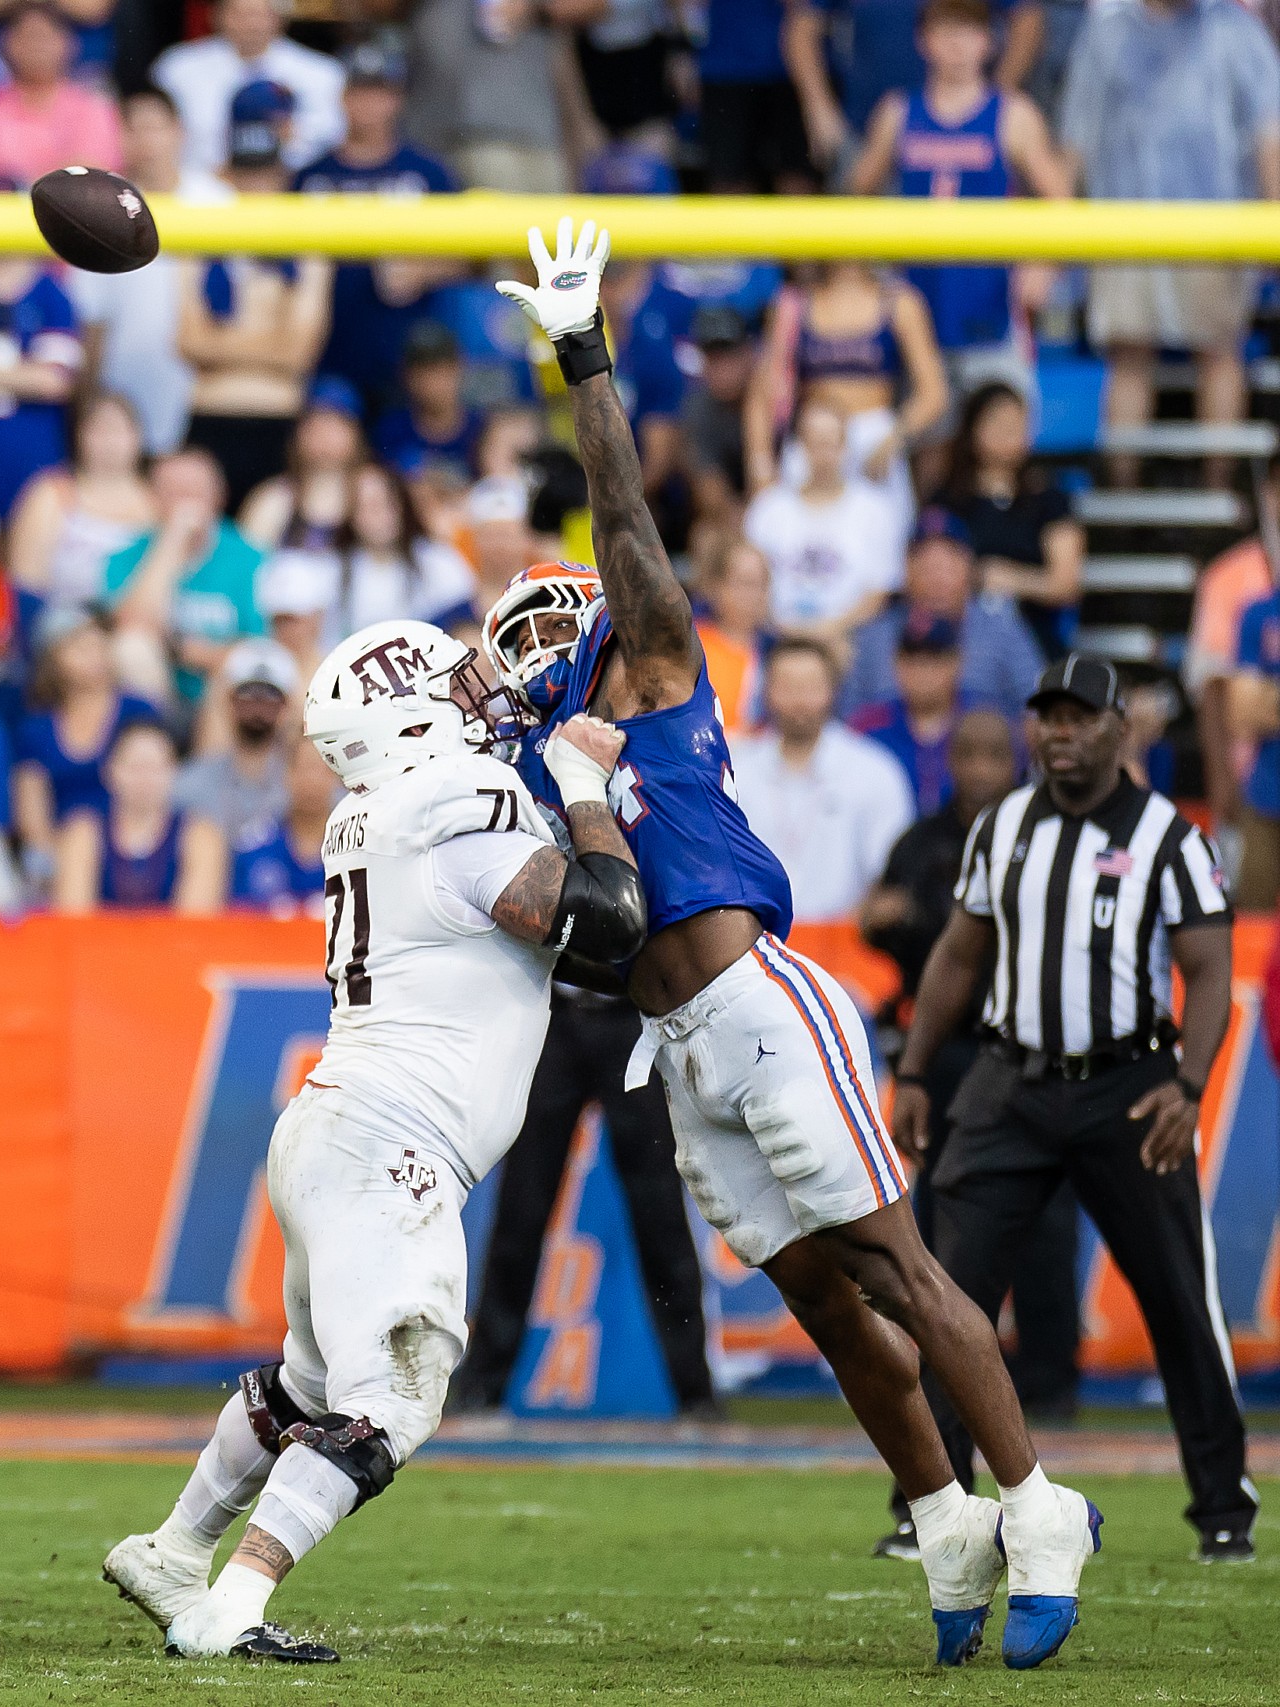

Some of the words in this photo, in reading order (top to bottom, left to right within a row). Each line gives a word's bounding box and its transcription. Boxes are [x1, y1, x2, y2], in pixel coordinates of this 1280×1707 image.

[476, 788, 518, 832] 71
[1094, 895, 1116, 929] U
[325, 868, 372, 1009] 71
